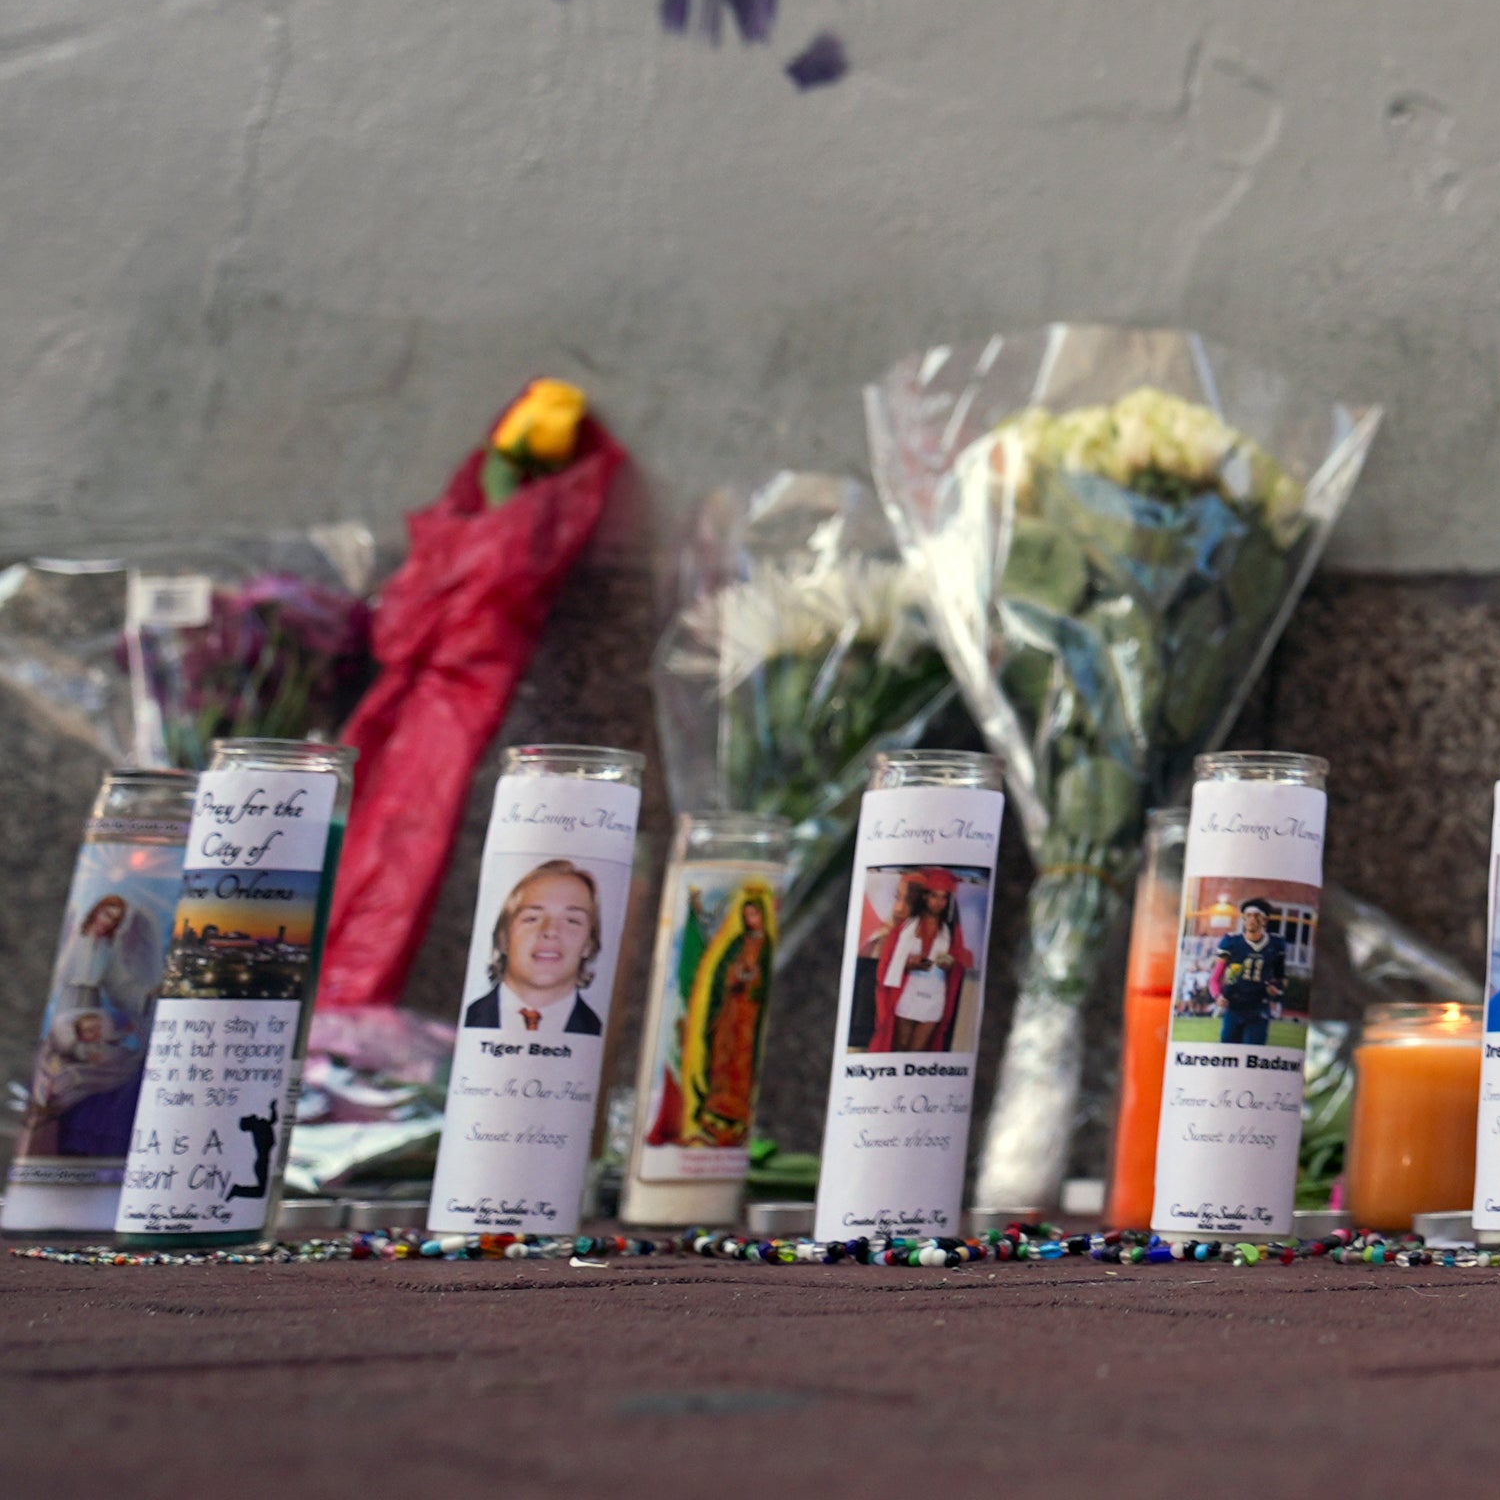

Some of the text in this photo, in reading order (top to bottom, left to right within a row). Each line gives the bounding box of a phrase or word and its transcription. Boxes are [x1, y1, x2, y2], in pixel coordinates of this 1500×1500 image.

[229, 789, 268, 824] for
[274, 789, 308, 818] the
[524, 803, 578, 831] Loving
[885, 818, 936, 846] Loving
[1222, 812, 1272, 841] Loving
[201, 831, 284, 866] City of
[214, 872, 295, 900] Orleans
[223, 1016, 258, 1039] stay
[268, 1015, 289, 1033] for
[191, 1042, 217, 1058] but
[480, 1041, 573, 1059] Tiger Bech
[1175, 1052, 1239, 1069] Kareem
[187, 1065, 214, 1081] the
[846, 1064, 897, 1080] Nikyra
[522, 1078, 551, 1099] Our
[1236, 1090, 1265, 1109] Our
[910, 1094, 939, 1114] Our
[172, 1130, 190, 1154] is
[203, 1128, 224, 1156] A
[187, 1164, 232, 1198] City
